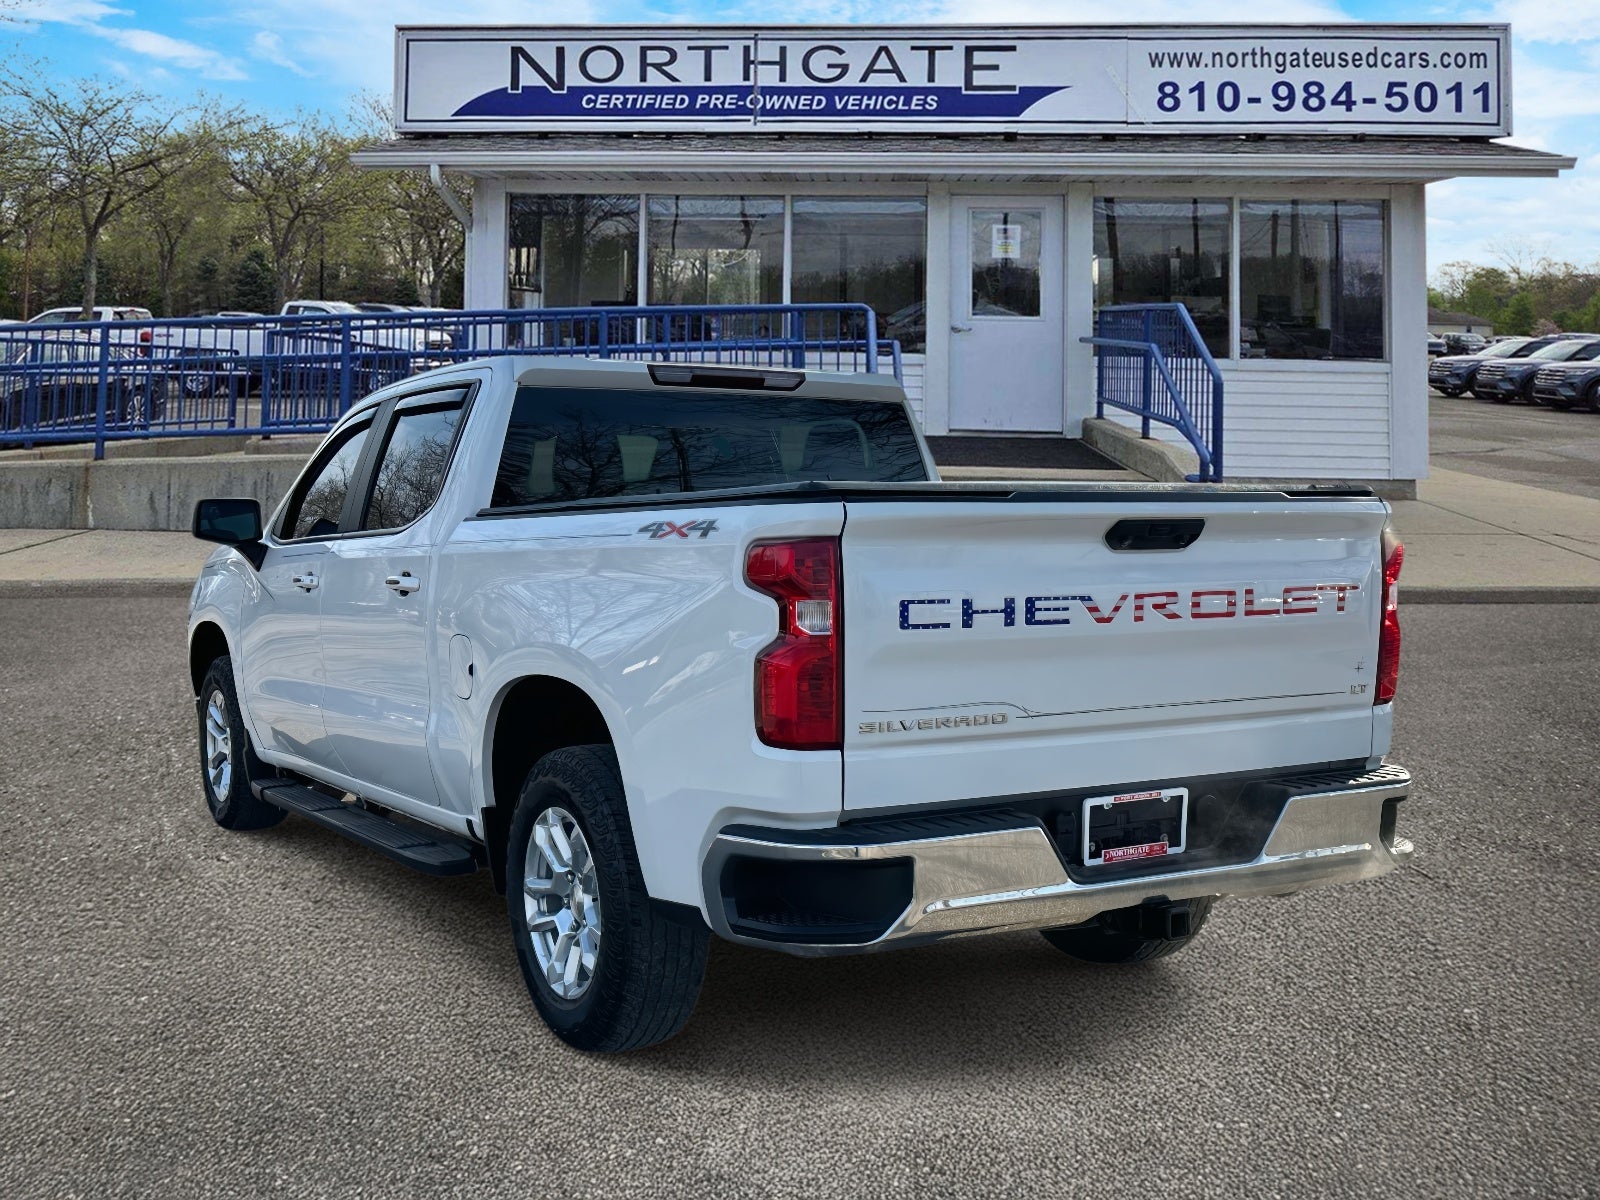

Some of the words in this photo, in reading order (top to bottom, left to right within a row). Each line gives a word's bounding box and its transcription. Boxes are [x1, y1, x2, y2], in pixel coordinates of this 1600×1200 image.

[510, 45, 1017, 92] NORTHGATE
[1148, 46, 1488, 73] www.northgateusedcars.com
[581, 94, 690, 110] CERTIFIED
[695, 94, 827, 110] PRE-OWNED
[834, 95, 939, 111] VEHICLES
[1156, 80, 1491, 114] 810-984-5011
[898, 584, 1360, 630] CHEVROLET
[858, 712, 1009, 735] SILVERADO
[1109, 846, 1149, 857] NORTHGATE
